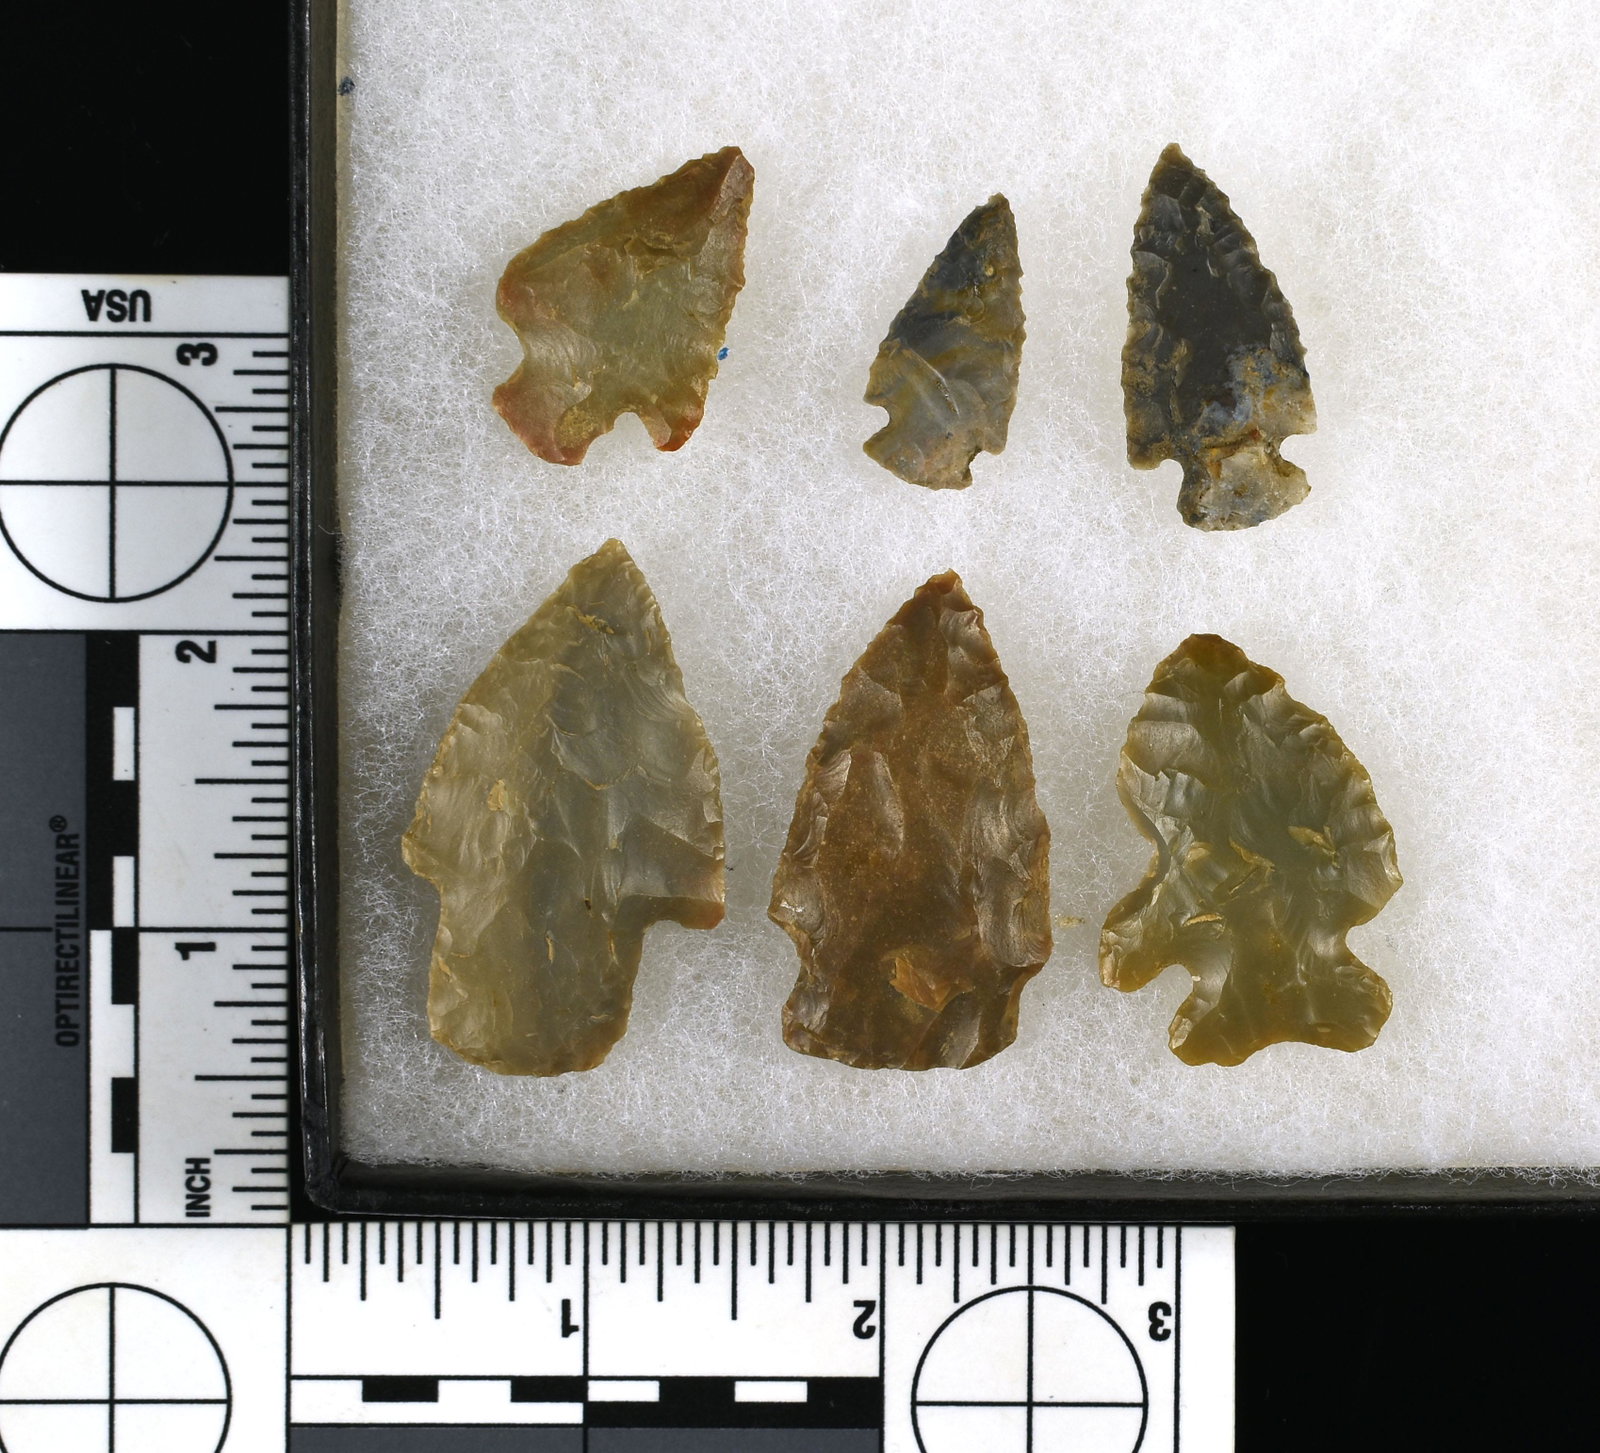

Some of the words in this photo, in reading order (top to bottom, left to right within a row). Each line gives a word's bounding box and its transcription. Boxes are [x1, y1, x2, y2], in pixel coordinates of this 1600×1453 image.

[82, 290, 151, 322] USA
[176, 343, 218, 366] 3
[175, 640, 216, 663] 2
[175, 942, 216, 960] 1
[185, 1158, 211, 1217] INCH
[562, 1299, 579, 1337] 1
[853, 1300, 876, 1339] 2
[1149, 1302, 1171, 1341] 3
